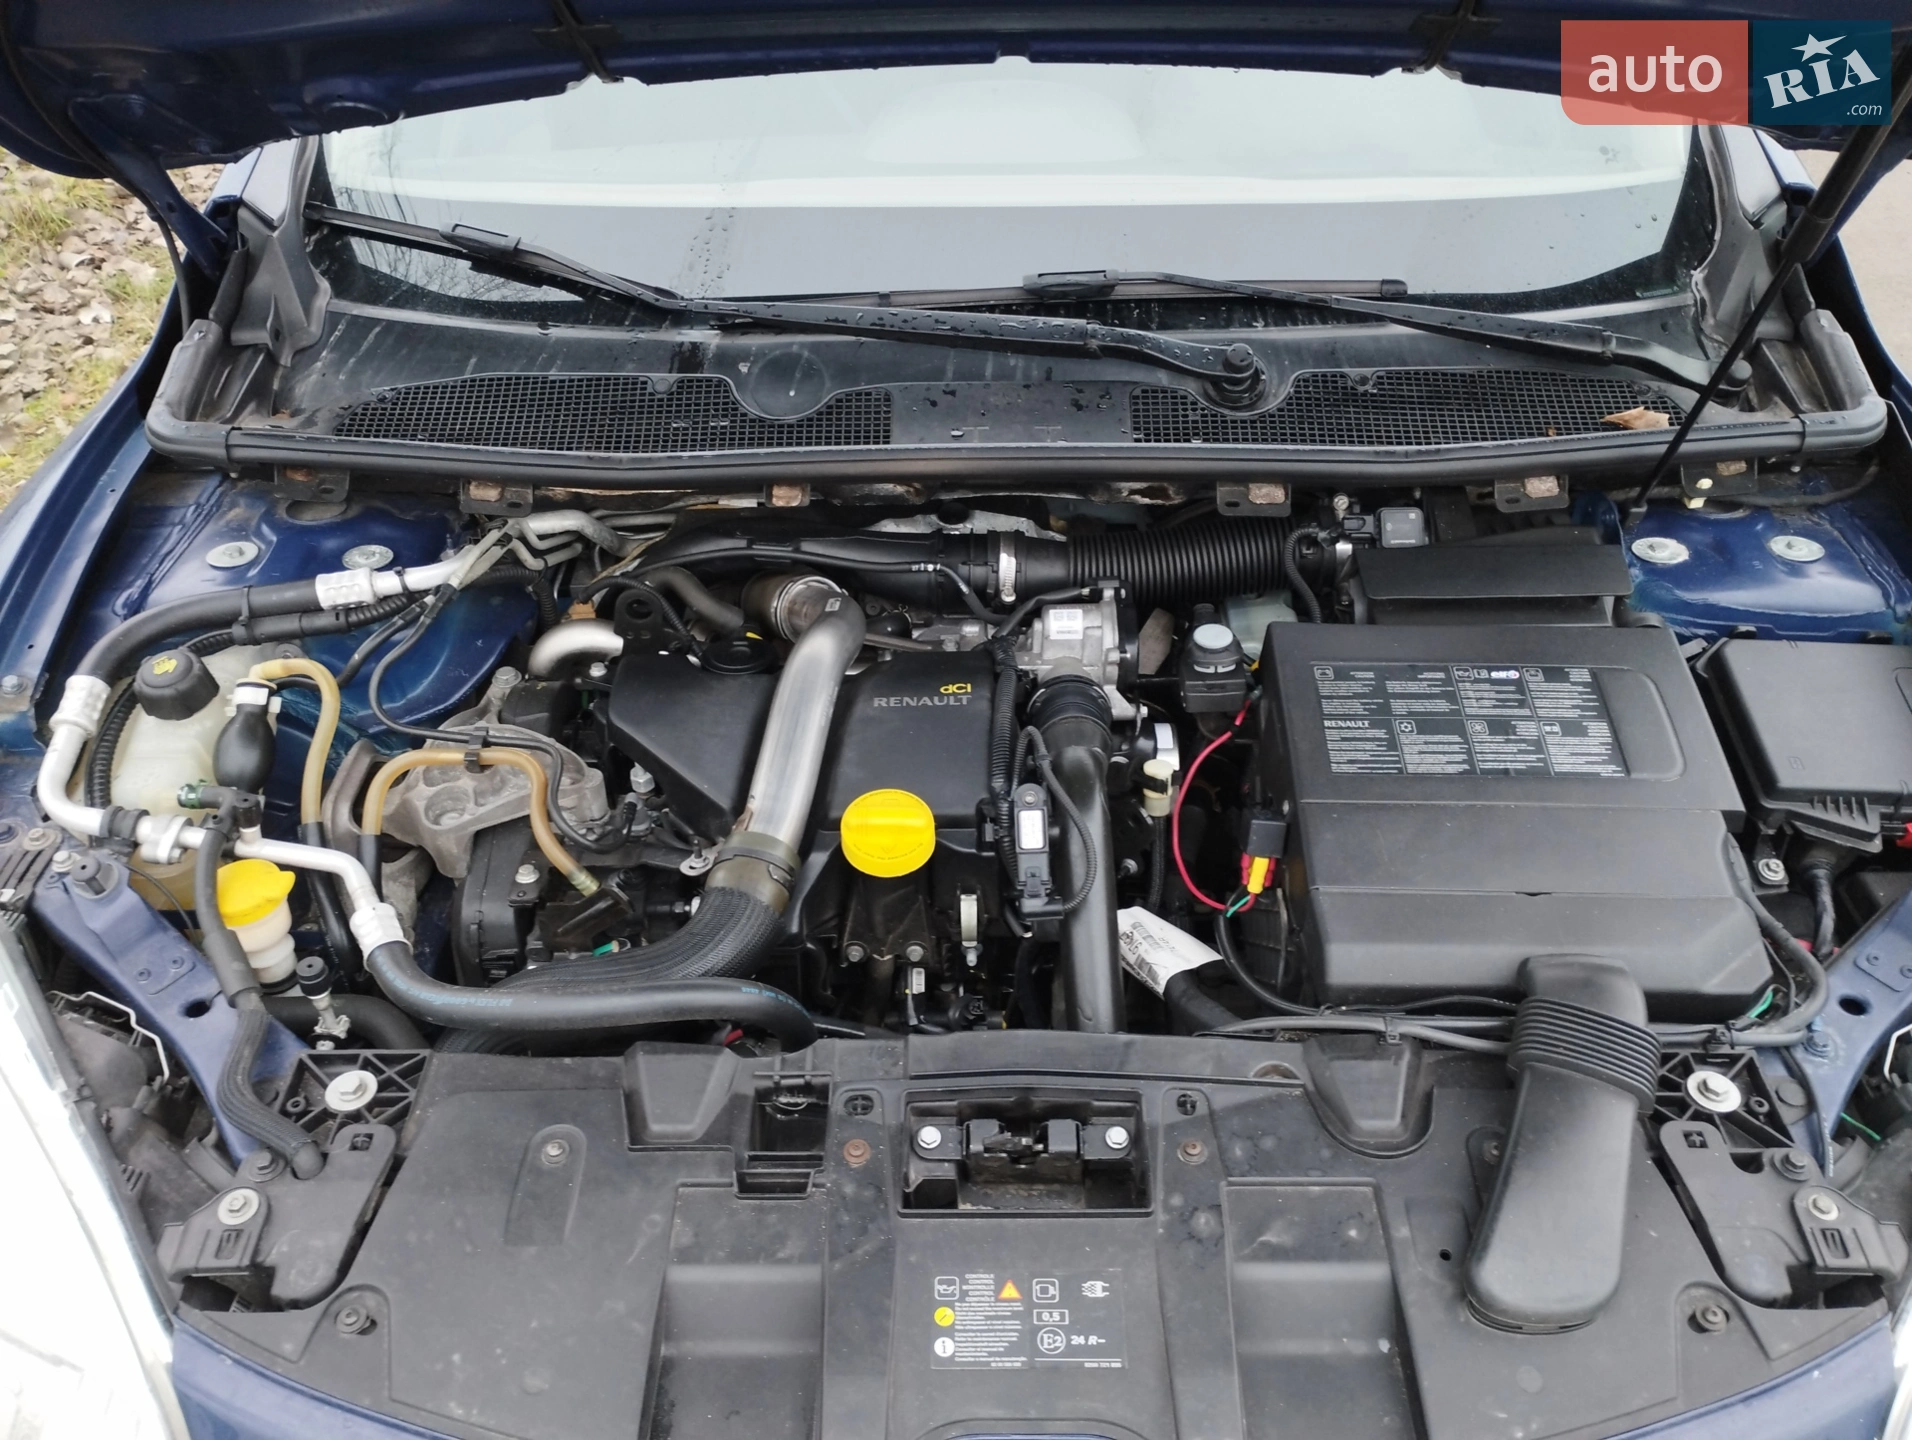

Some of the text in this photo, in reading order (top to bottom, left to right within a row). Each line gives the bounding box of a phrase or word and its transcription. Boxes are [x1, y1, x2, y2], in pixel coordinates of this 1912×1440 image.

[873, 695, 972, 707] RENAULT
[1323, 720, 1370, 728] RENAULT
[1042, 1312, 1060, 1322] 0,5
[1042, 1334, 1062, 1349] E2
[1070, 1335, 1086, 1345] 24
